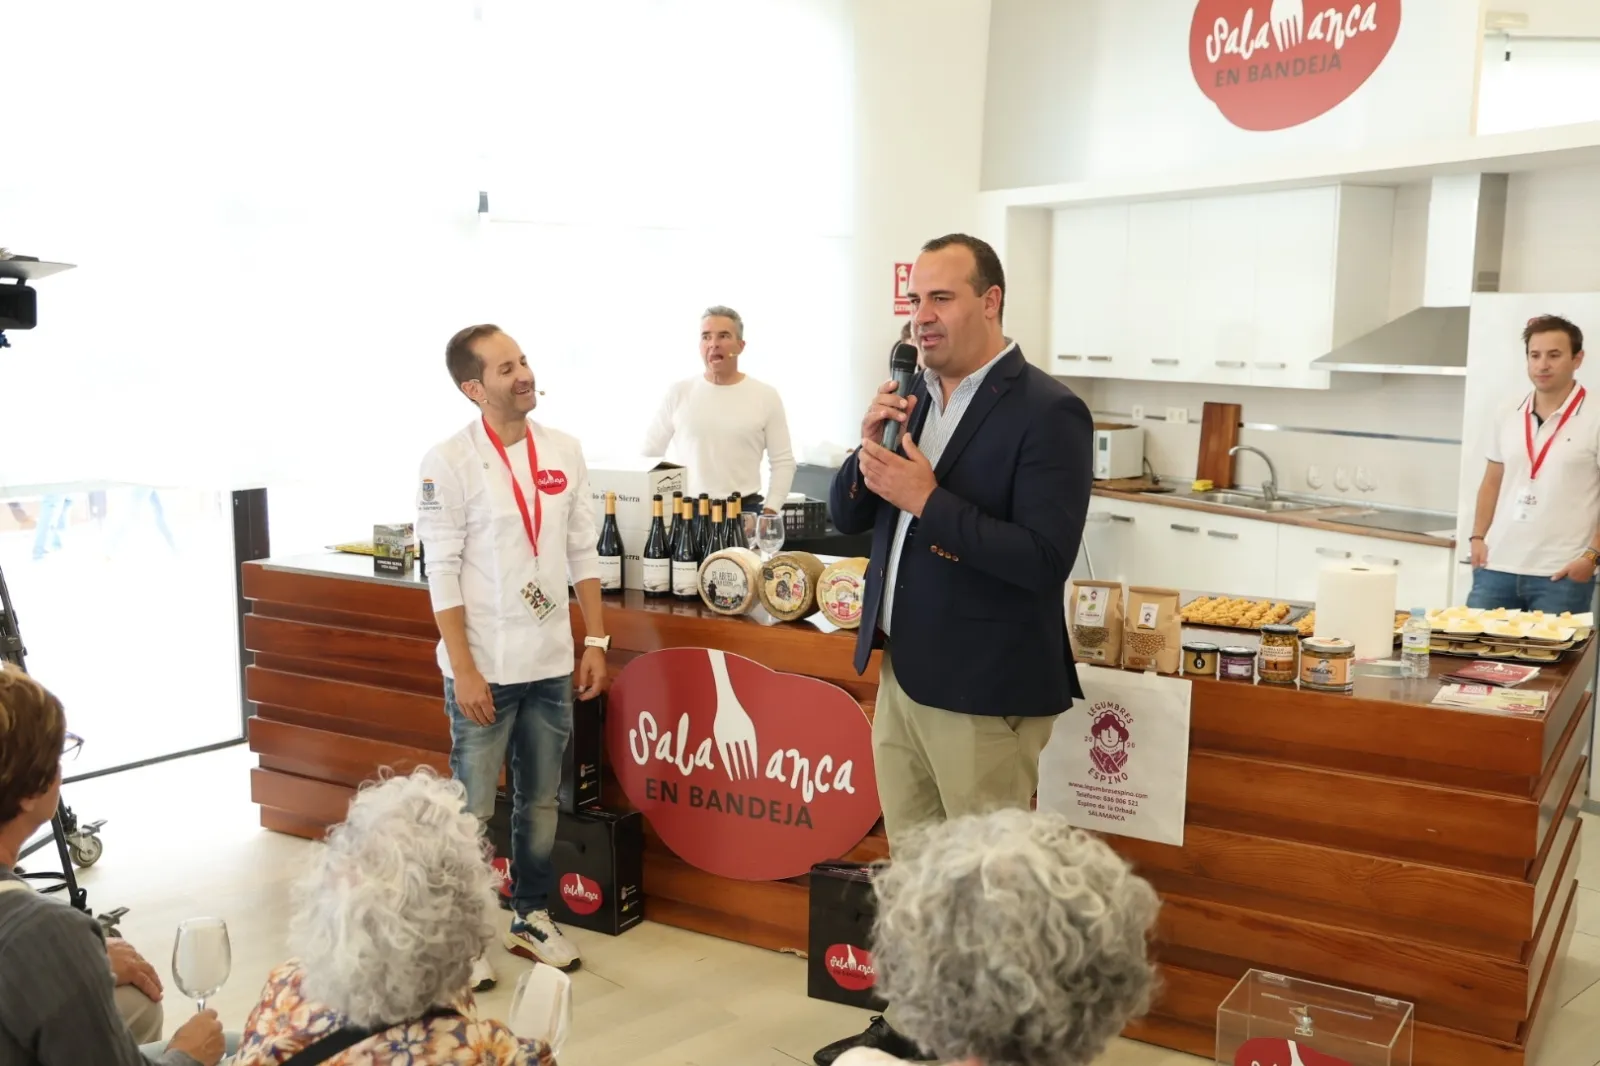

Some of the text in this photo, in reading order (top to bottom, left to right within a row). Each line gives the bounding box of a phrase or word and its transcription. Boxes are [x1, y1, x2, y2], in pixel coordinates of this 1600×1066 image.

[1214, 52, 1342, 88] EN BANDEJA
[618, 494, 640, 502] Sierra
[1087, 701, 1134, 724] LEGUMBRES
[629, 708, 856, 803] Salamanca
[1088, 767, 1128, 784] ESPINO
[645, 778, 813, 830] EN BANDEJA
[1077, 800, 1097, 809] Espino
[1088, 810, 1125, 822] SALAMANCA
